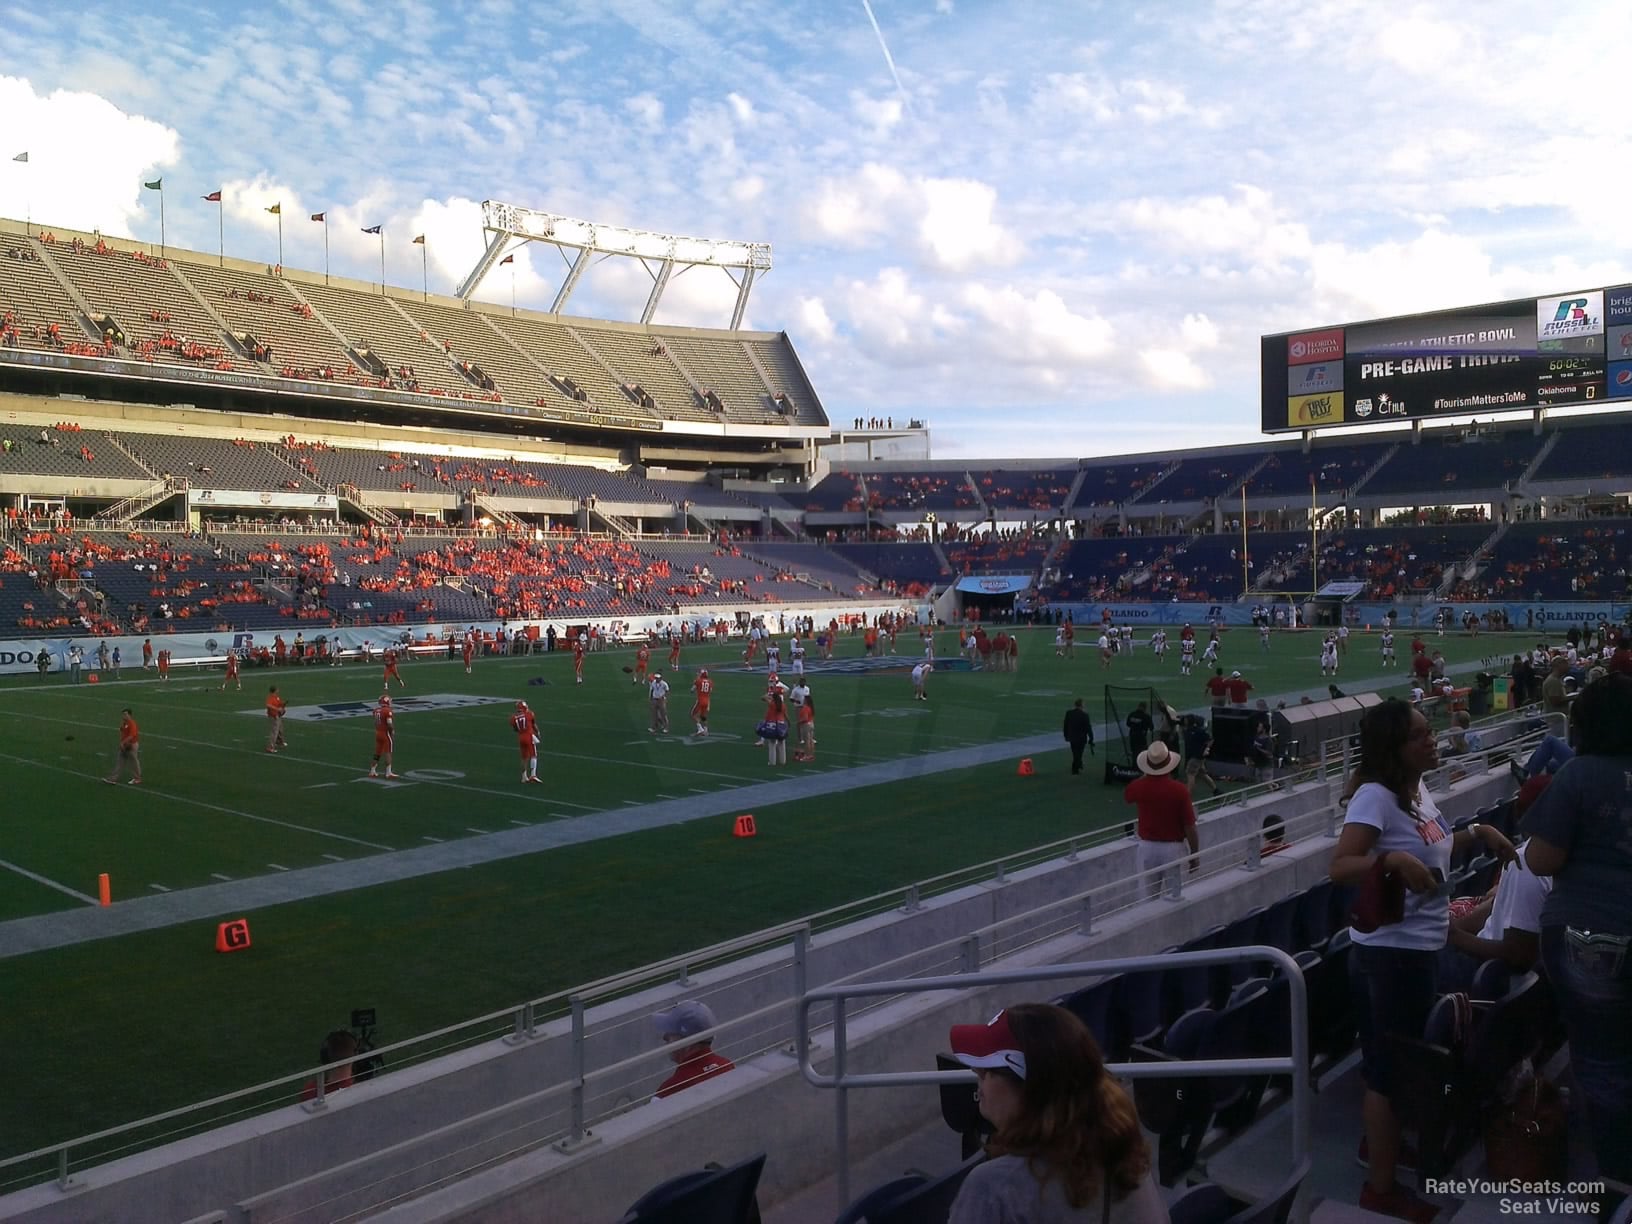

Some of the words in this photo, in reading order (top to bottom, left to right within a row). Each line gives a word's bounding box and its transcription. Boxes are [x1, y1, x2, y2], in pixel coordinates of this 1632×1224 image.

[1478, 328, 1516, 342] BOWL
[1311, 339, 1337, 348] FLORIDA
[1311, 346, 1340, 355] HOSPITAL
[1361, 355, 1453, 379] PRE-GAME
[1538, 386, 1577, 396] Oklahoma
[1586, 386, 1595, 399] 0
[1307, 396, 1331, 410] TIRES
[1434, 391, 1527, 409] #TourismMattersToMe
[1535, 611, 1608, 621] ORLANDO
[701, 681, 710, 693] 18
[515, 717, 526, 730] 17
[740, 817, 753, 833] 10
[224, 923, 247, 947] G
[1177, 1089, 1183, 1100] E
[1445, 1084, 1452, 1095] F
